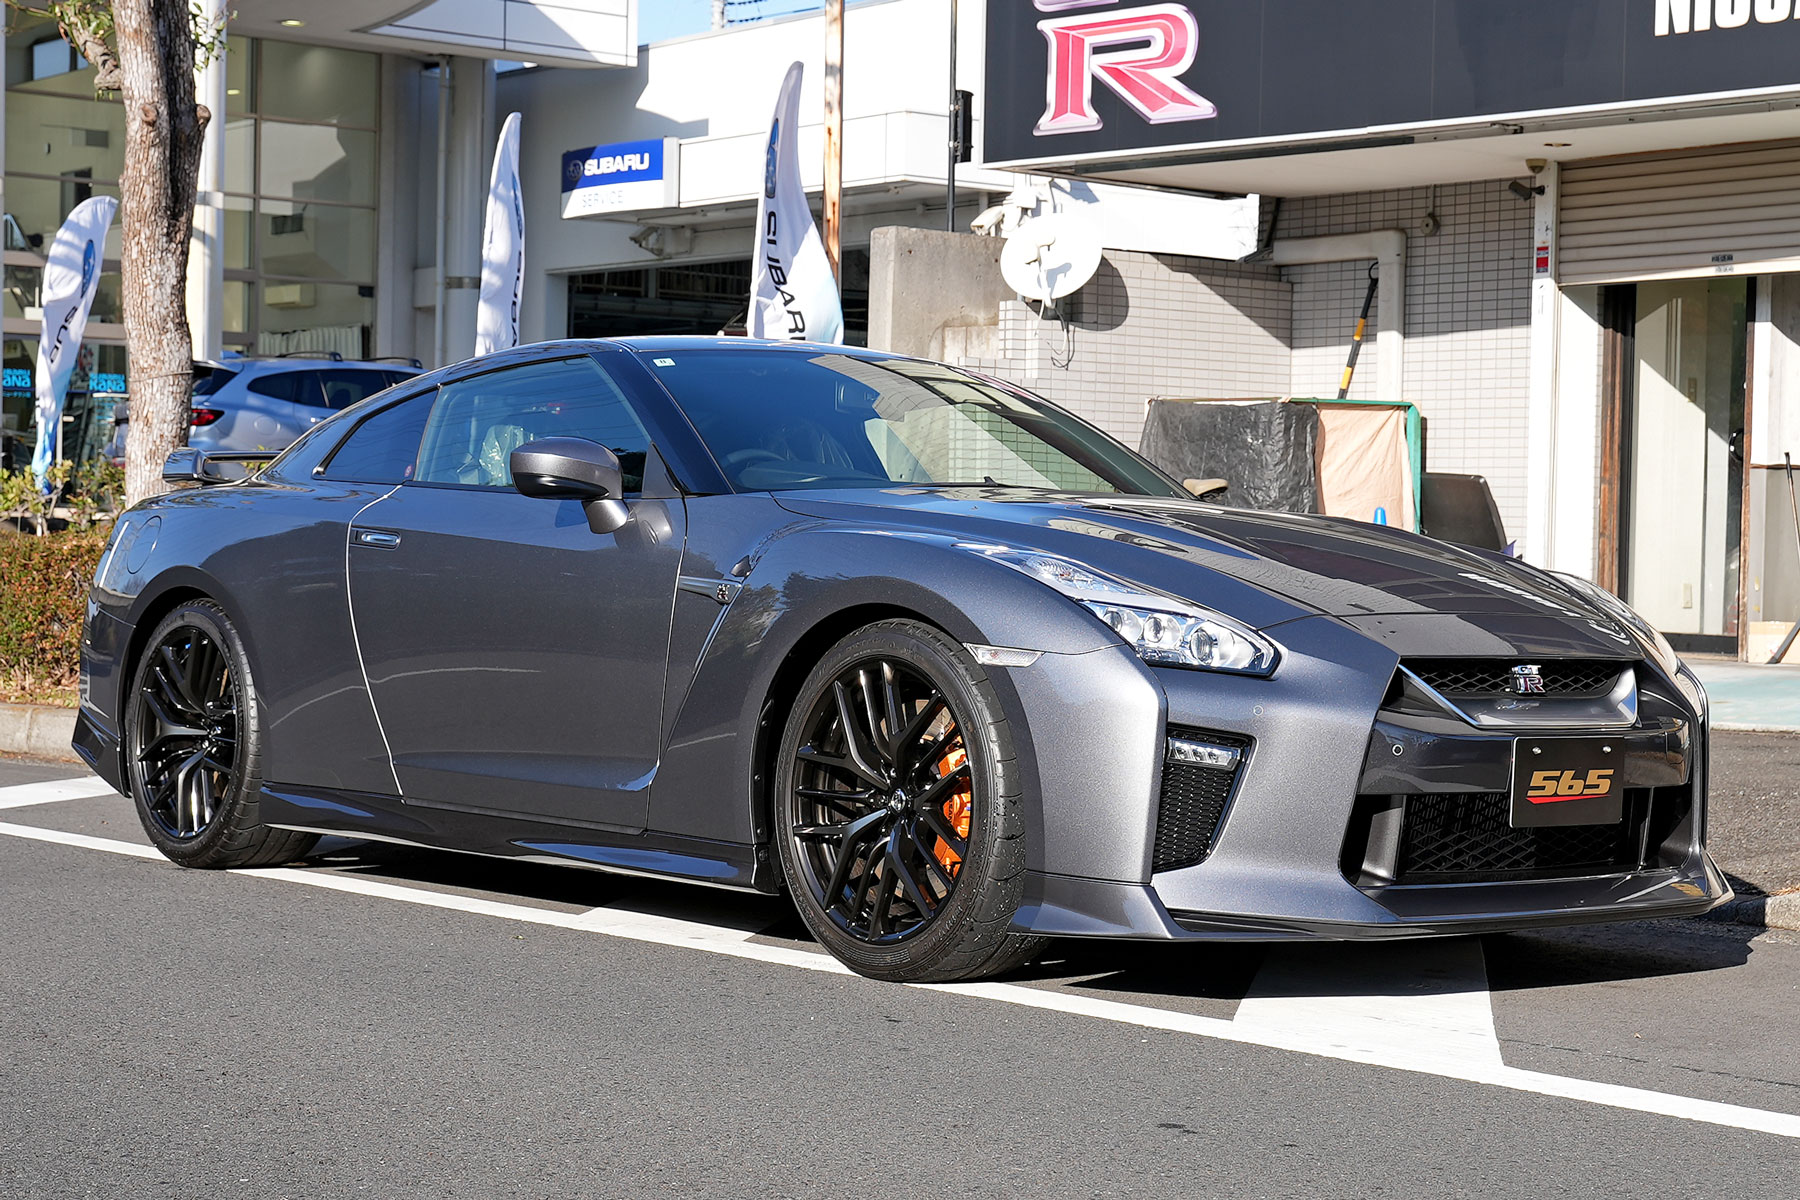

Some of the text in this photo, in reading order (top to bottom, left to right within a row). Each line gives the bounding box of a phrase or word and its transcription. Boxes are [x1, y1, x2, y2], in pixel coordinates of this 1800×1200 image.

[1033, 3, 1217, 136] R
[583, 152, 650, 176] SUBARU
[1527, 769, 1614, 796] 565
